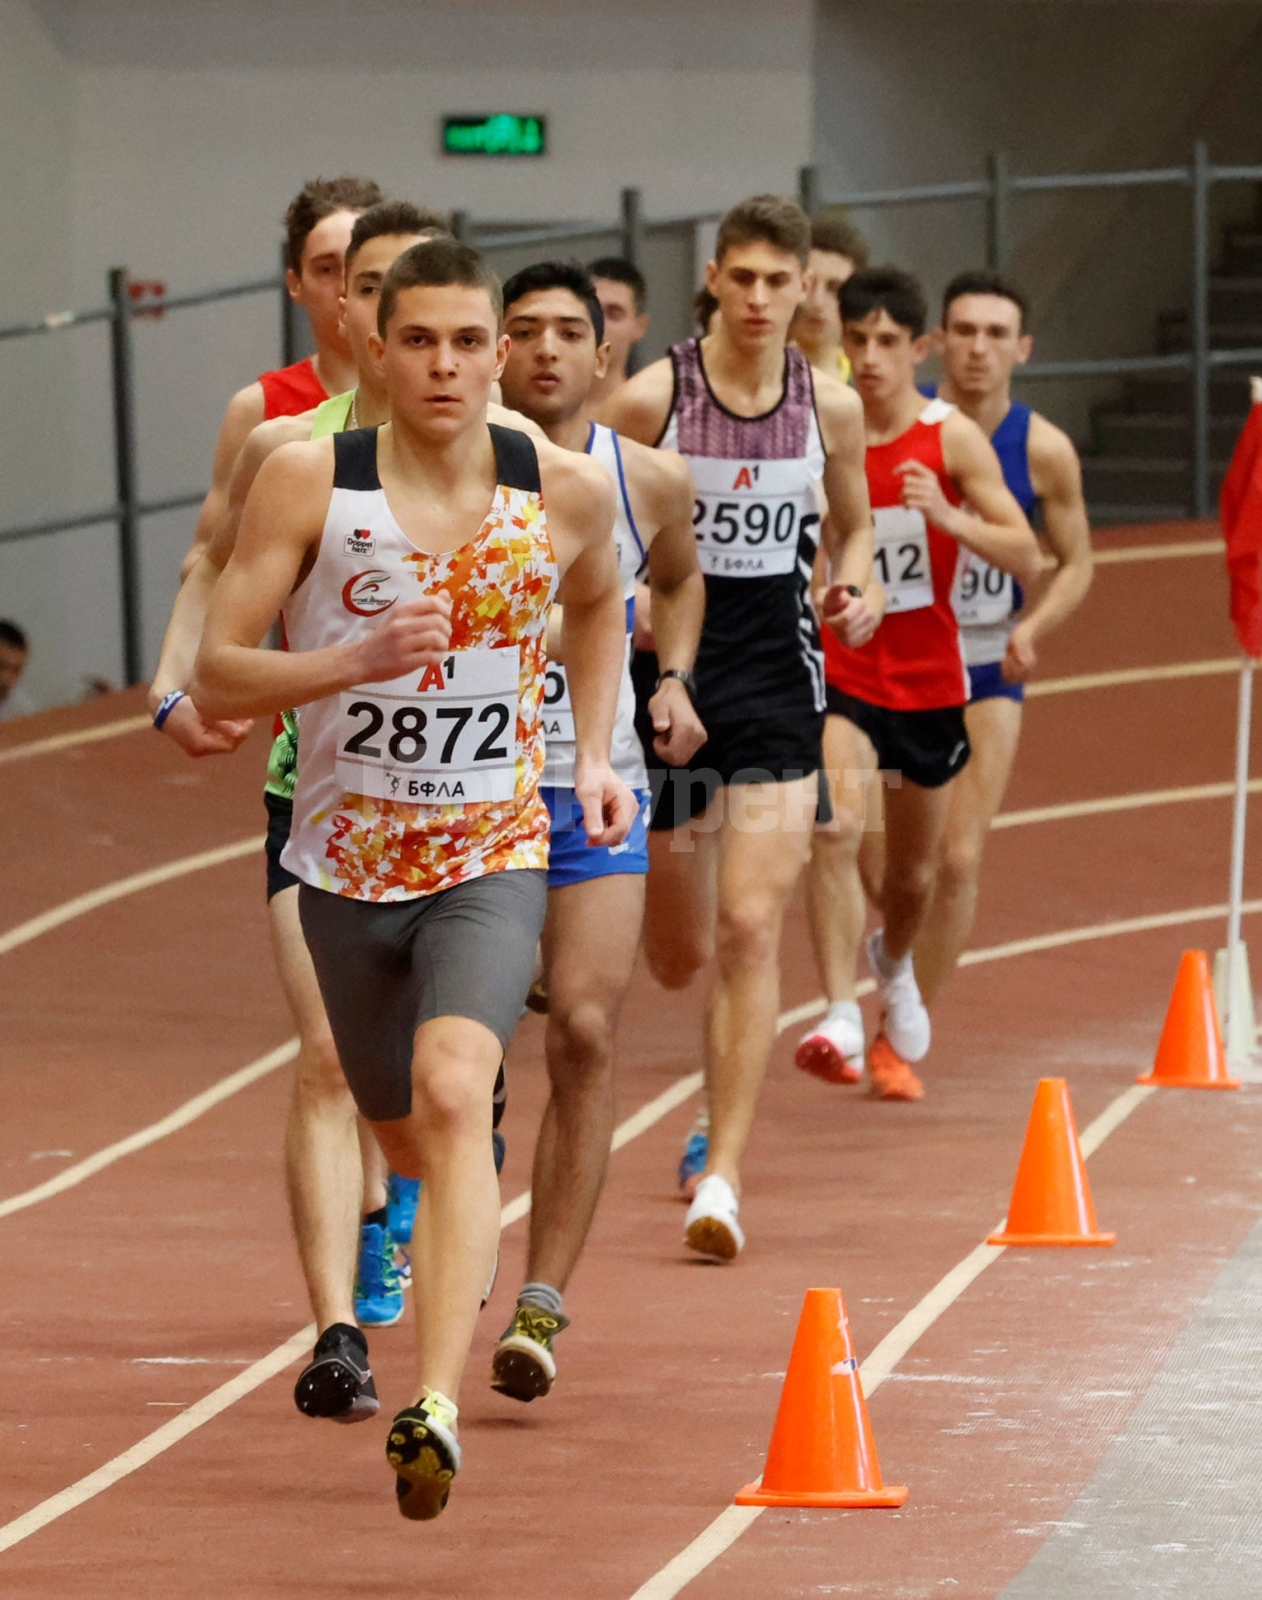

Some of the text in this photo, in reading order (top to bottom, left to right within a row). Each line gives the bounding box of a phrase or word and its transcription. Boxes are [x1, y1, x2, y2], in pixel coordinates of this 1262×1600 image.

[692, 499, 795, 545] 2590
[346, 537, 373, 548] Doppel
[351, 546, 367, 554] herz
[873, 543, 923, 583] 12
[343, 701, 510, 764] 2872
[408, 780, 465, 797] БФЛА
